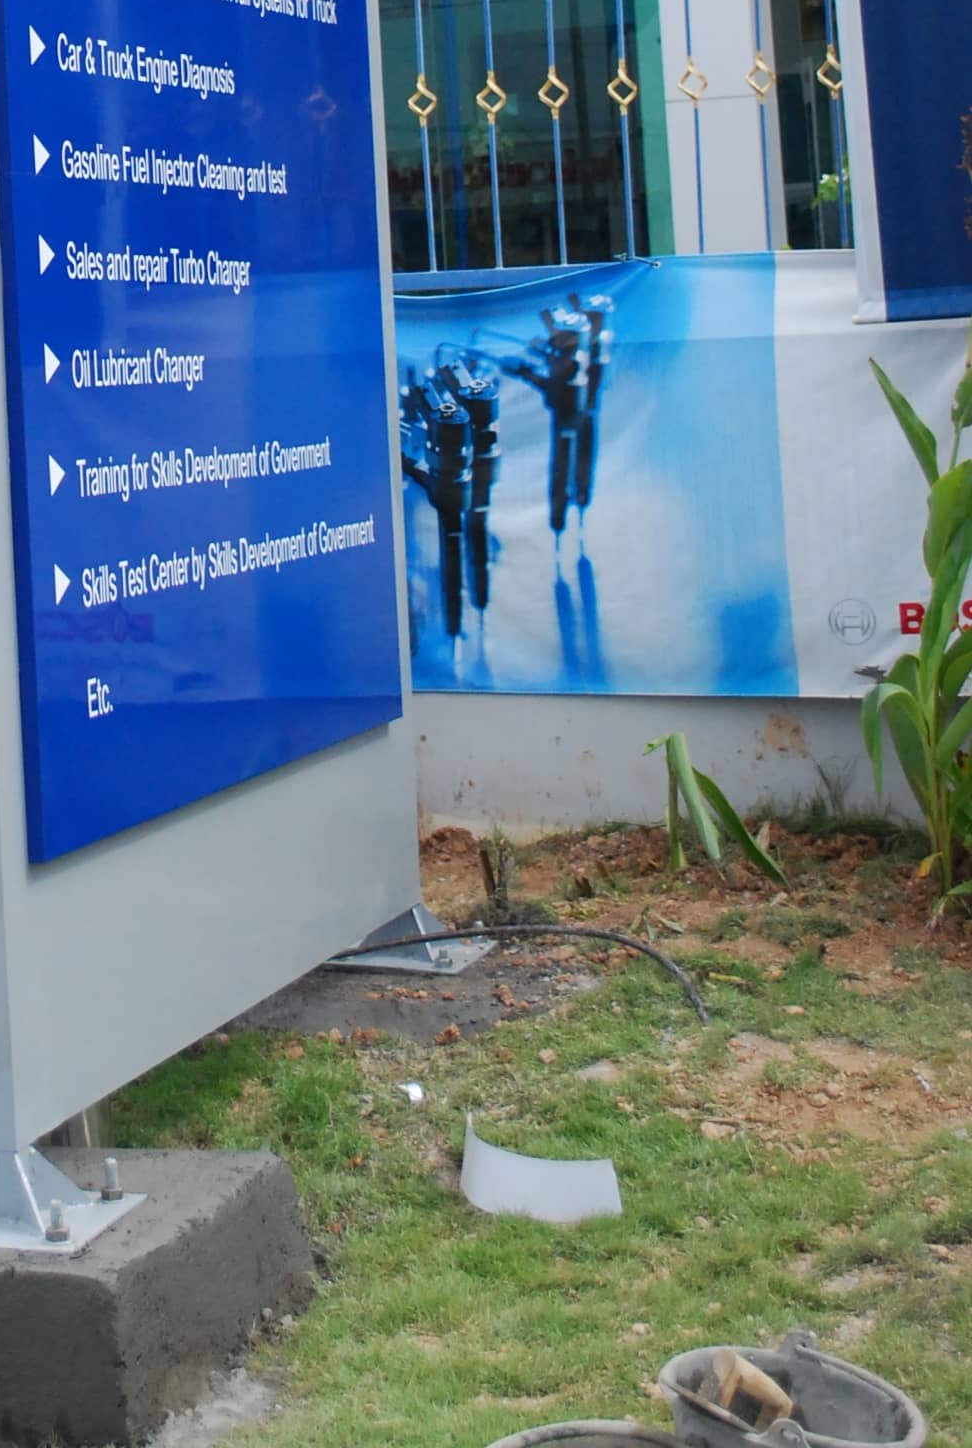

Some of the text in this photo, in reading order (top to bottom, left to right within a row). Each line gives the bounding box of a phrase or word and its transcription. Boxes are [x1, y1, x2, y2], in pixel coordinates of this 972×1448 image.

[57, 33, 235, 100] Car & Truck Engine Diagnosis
[62, 140, 288, 201] Gasoline Fuel Injector Cleaning and test
[66, 241, 251, 295] Sales and repair Turbo Charger
[72, 347, 205, 391] Oil Lubricant Changer
[76, 435, 332, 502] Training for Skills Development of Government
[82, 514, 375, 608] Skills Test Center by Skills Development of Government
[87, 678, 113, 718] Etc.
